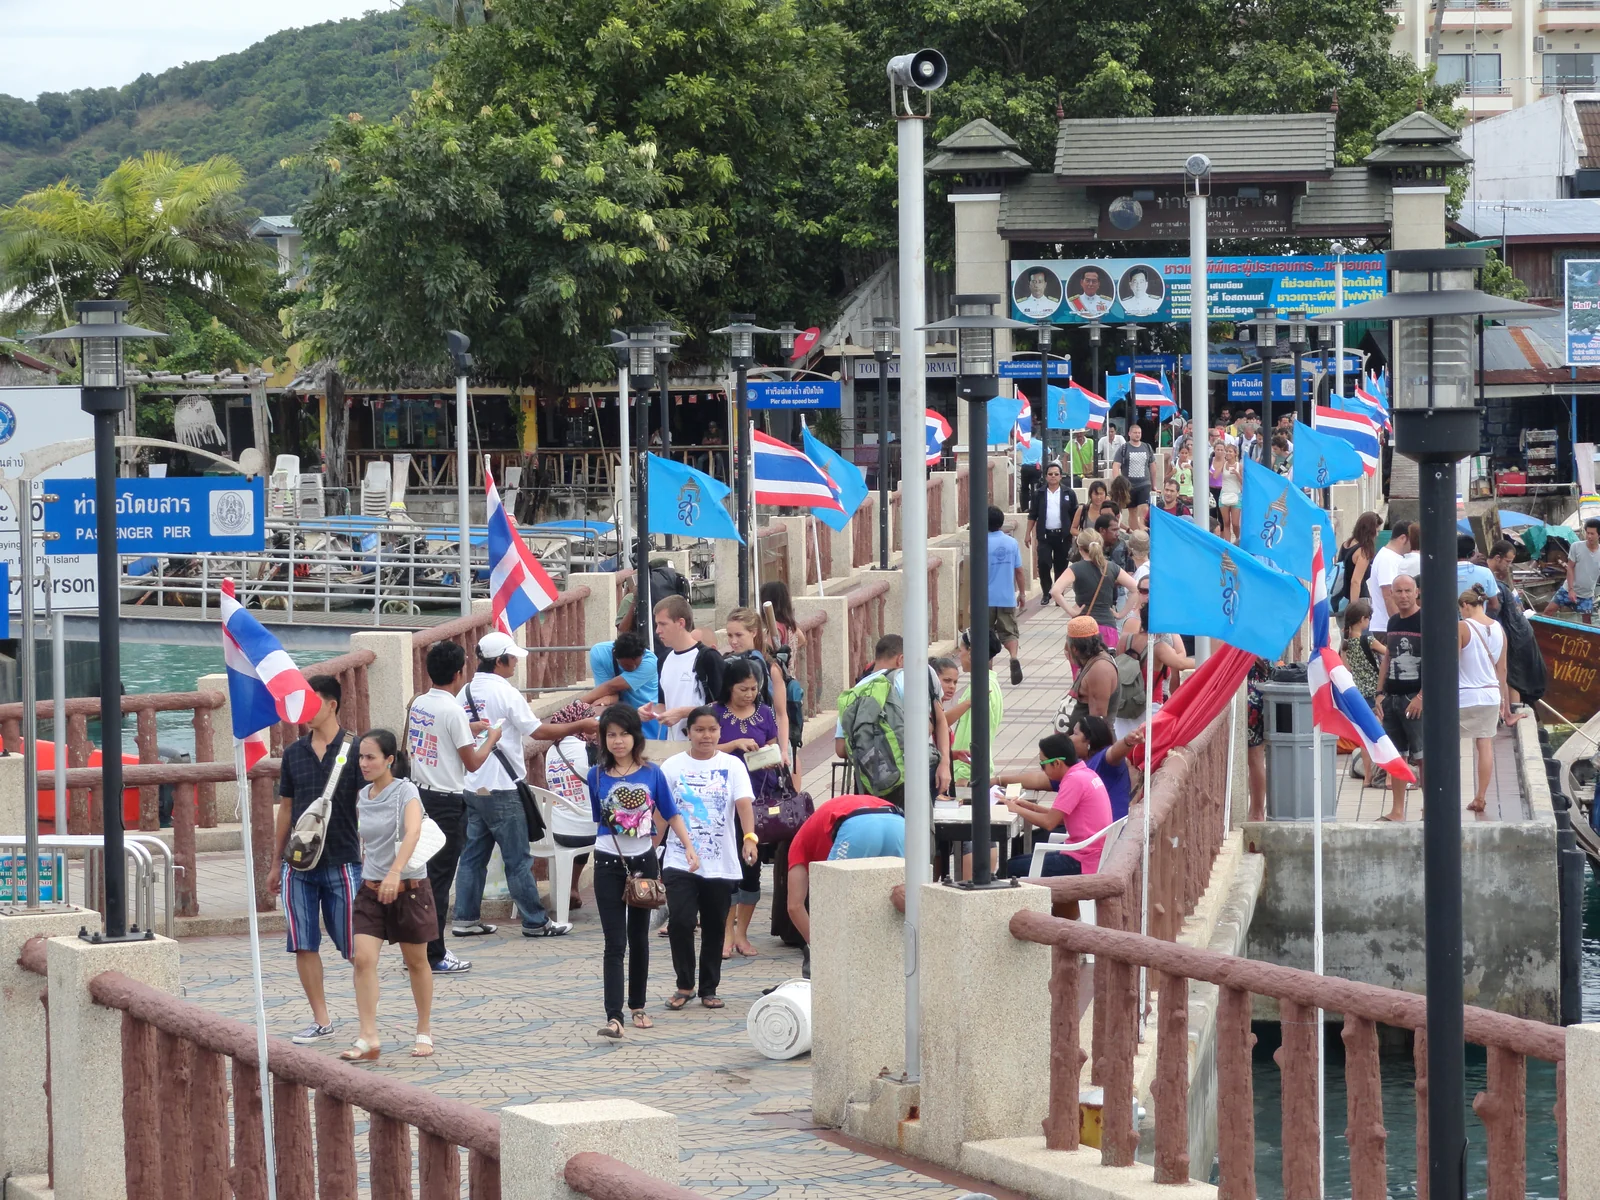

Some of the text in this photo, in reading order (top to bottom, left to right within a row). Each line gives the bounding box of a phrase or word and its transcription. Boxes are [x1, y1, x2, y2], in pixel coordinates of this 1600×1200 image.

[1573, 301, 1591, 310] Half
[792, 398, 807, 406] speed
[163, 526, 191, 538] PIER
[54, 555, 80, 564] Island
